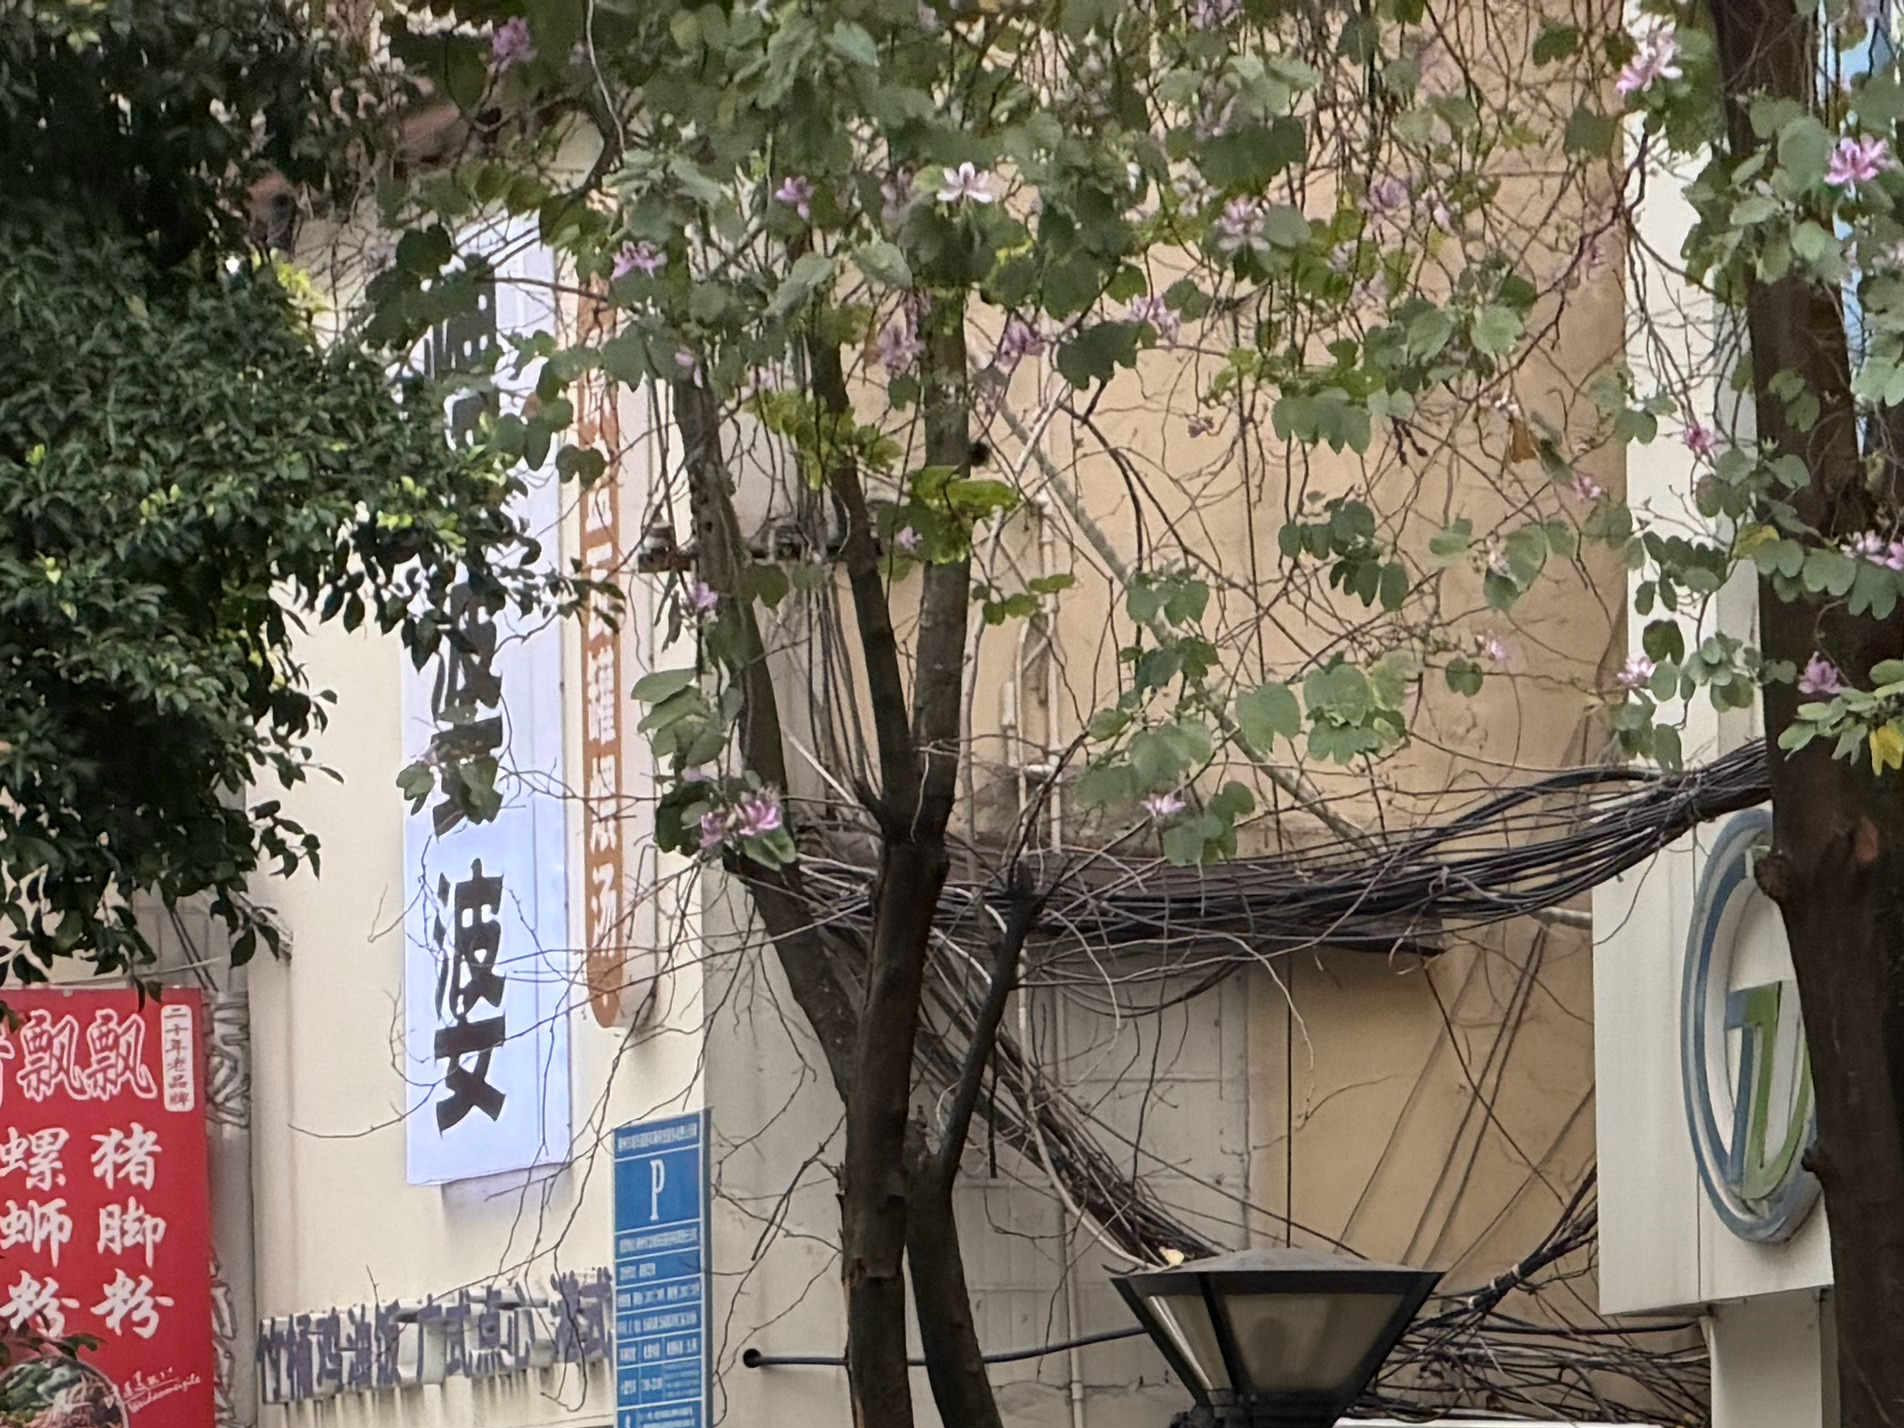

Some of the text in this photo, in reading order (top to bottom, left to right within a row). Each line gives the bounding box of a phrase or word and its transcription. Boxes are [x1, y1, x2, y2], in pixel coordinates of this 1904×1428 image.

[164, 1008, 192, 1109] 二十年老品牌
[90, 1121, 175, 1340] 猪脚粉
[649, 1158, 666, 1222] P
